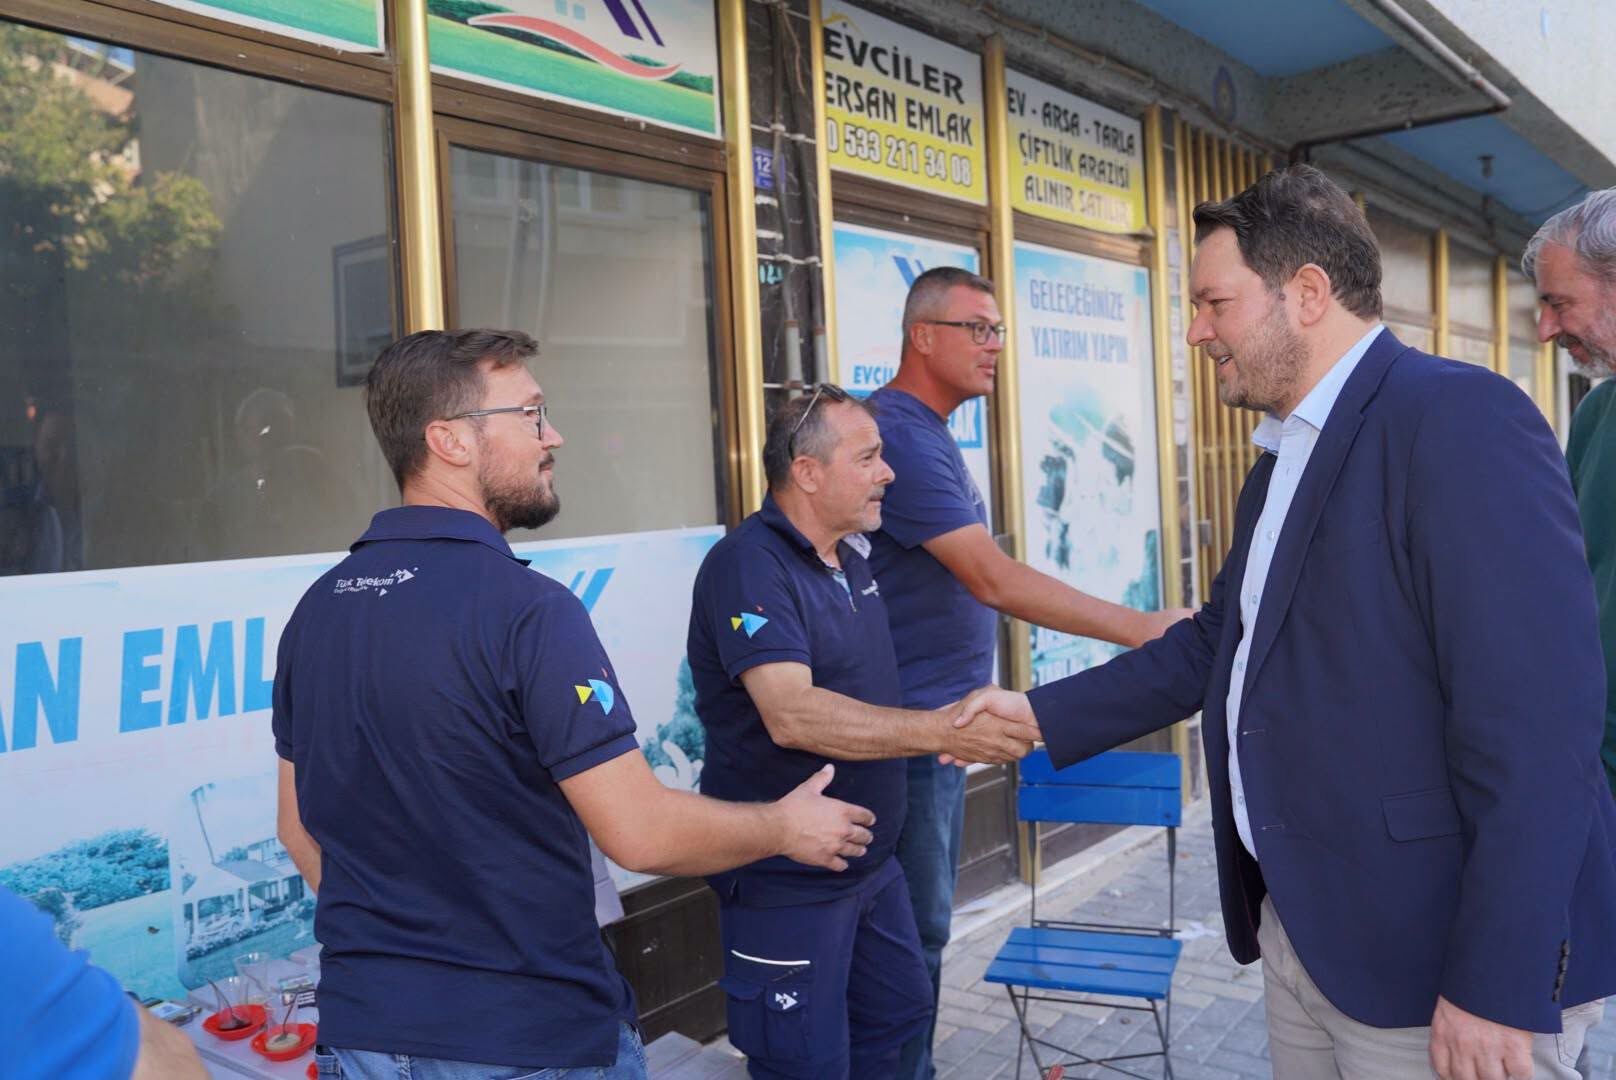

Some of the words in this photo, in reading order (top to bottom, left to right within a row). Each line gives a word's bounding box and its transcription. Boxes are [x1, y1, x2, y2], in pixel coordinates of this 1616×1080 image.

[823, 26, 965, 104] EVCİLER
[825, 70, 897, 123] ERSAN
[905, 98, 973, 146] EMLAK
[1007, 87, 1026, 117] EV
[1042, 102, 1080, 137] ARSA
[1093, 120, 1136, 157] TARLA
[755, 155, 771, 173] 12
[843, 122, 882, 164] 533
[885, 134, 919, 174] 211
[924, 145, 948, 181] 34
[950, 152, 973, 187] 08
[0, 637, 82, 753] N
[119, 617, 274, 733] EML
